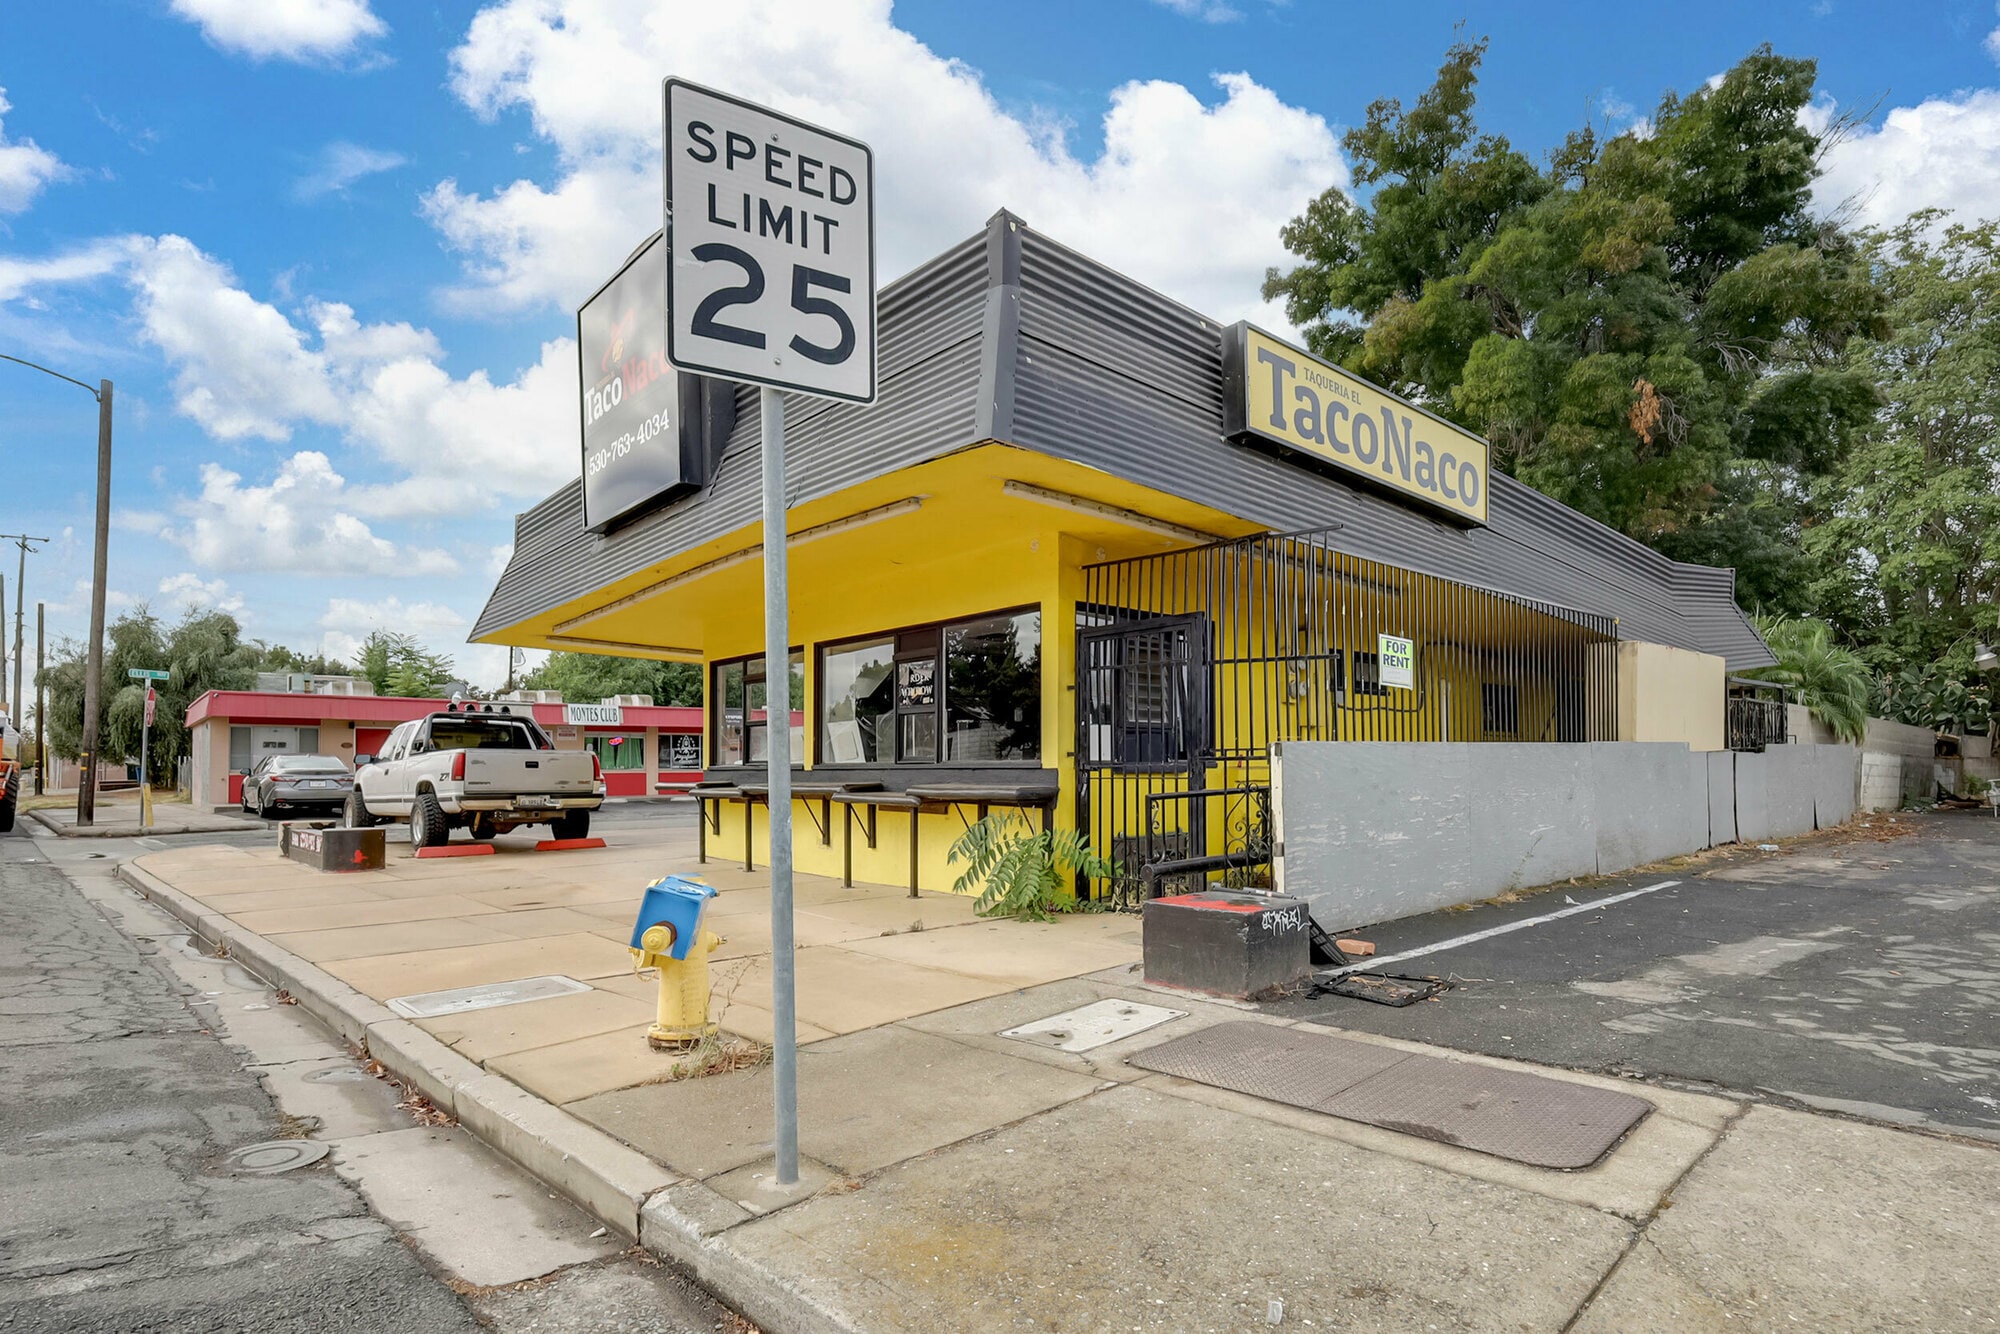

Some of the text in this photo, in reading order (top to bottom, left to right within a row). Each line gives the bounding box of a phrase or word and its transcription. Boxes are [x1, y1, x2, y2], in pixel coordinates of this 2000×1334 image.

[686, 120, 857, 206] SPEED
[708, 183, 839, 255] LIMIT
[690, 243, 856, 365] 25
[1303, 366, 1362, 405] TAQUERIA EL
[589, 407, 670, 476] 530-763-4034
[1257, 346, 1479, 508] TacoNaco
[1383, 653, 1410, 669] RENT
[1386, 640, 1407, 655] FOR
[570, 707, 618, 722] MONTES CLUB
